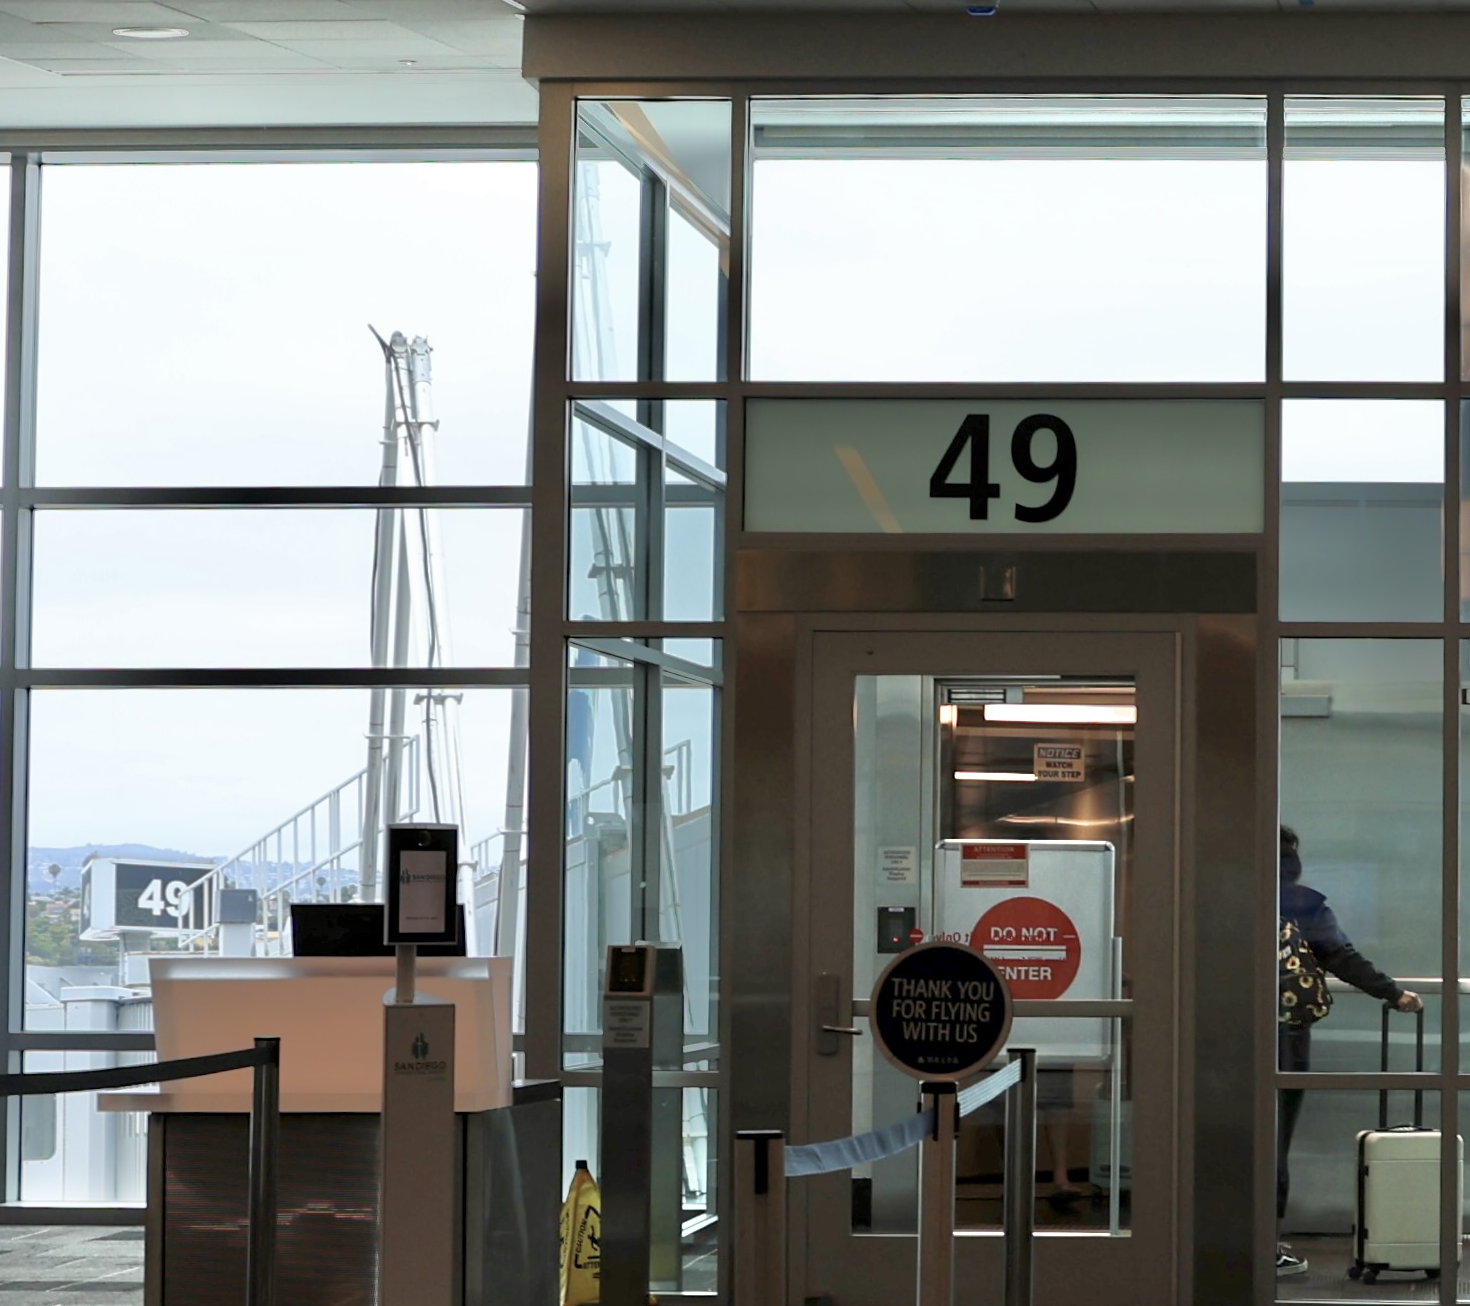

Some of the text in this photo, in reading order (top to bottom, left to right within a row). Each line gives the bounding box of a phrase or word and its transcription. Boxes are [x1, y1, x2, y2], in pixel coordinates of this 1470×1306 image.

[929, 413, 1077, 523] 49
[1038, 748, 1079, 759] NOTICE
[1038, 770, 1081, 778] YOUR STEP
[1045, 761, 1073, 769] WATCH
[137, 879, 191, 917] 49
[990, 926, 1016, 941] DO
[1021, 926, 1058, 941] NOT
[891, 977, 995, 1001] THANK YOU
[892, 999, 991, 1023] FOR FLYING
[902, 1021, 978, 1043] WITH US
